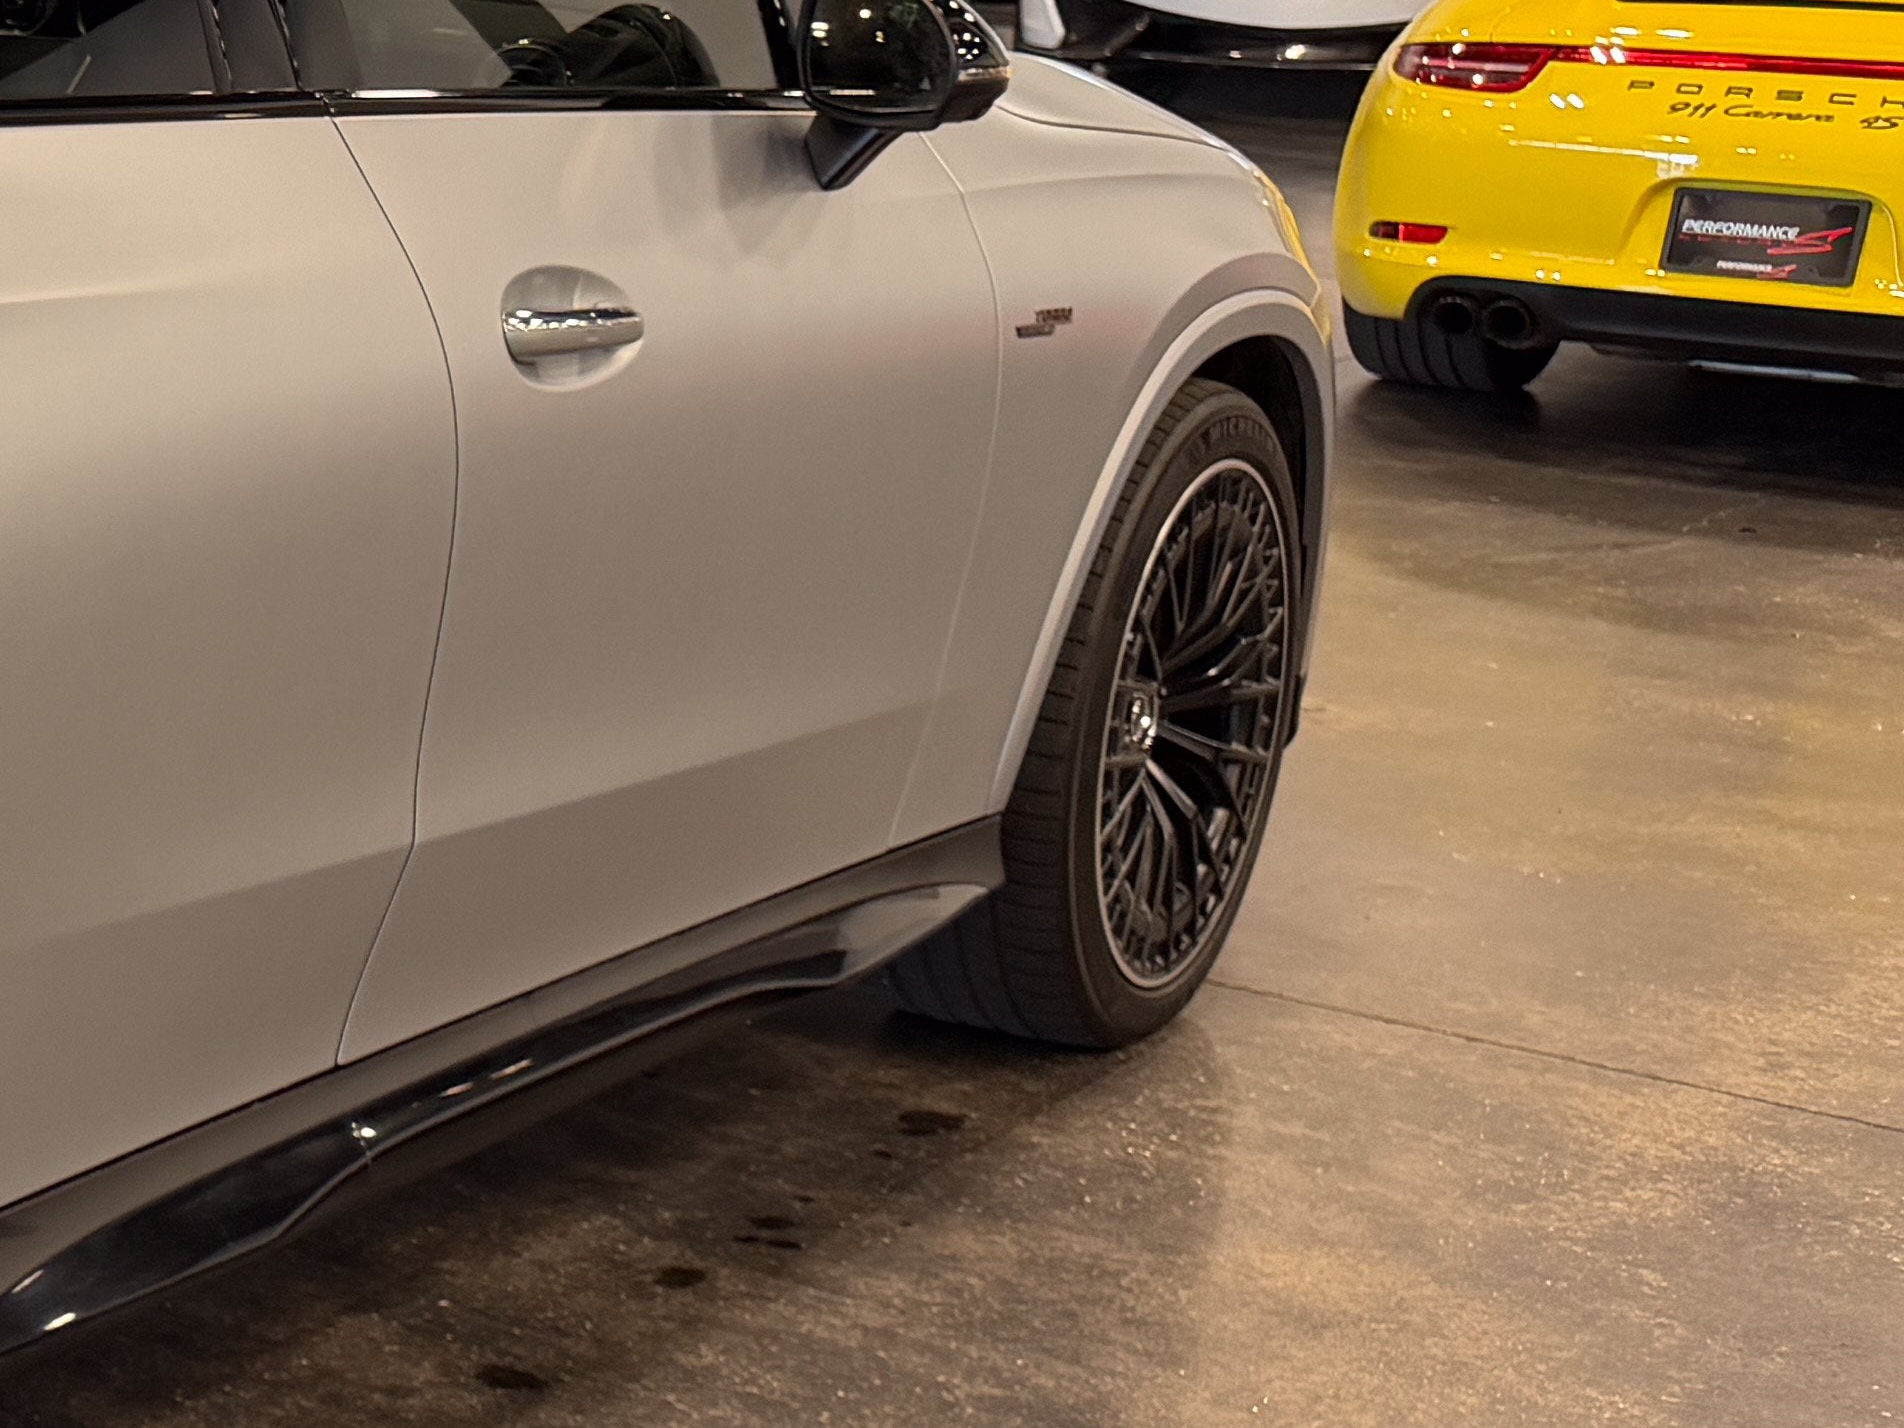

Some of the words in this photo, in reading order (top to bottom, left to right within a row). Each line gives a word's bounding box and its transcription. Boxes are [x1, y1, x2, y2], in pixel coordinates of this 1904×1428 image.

[1667, 101, 1718, 119] 911
[1723, 104, 1835, 123] Carrera
[1681, 218, 1800, 241] PERFORMANCE
